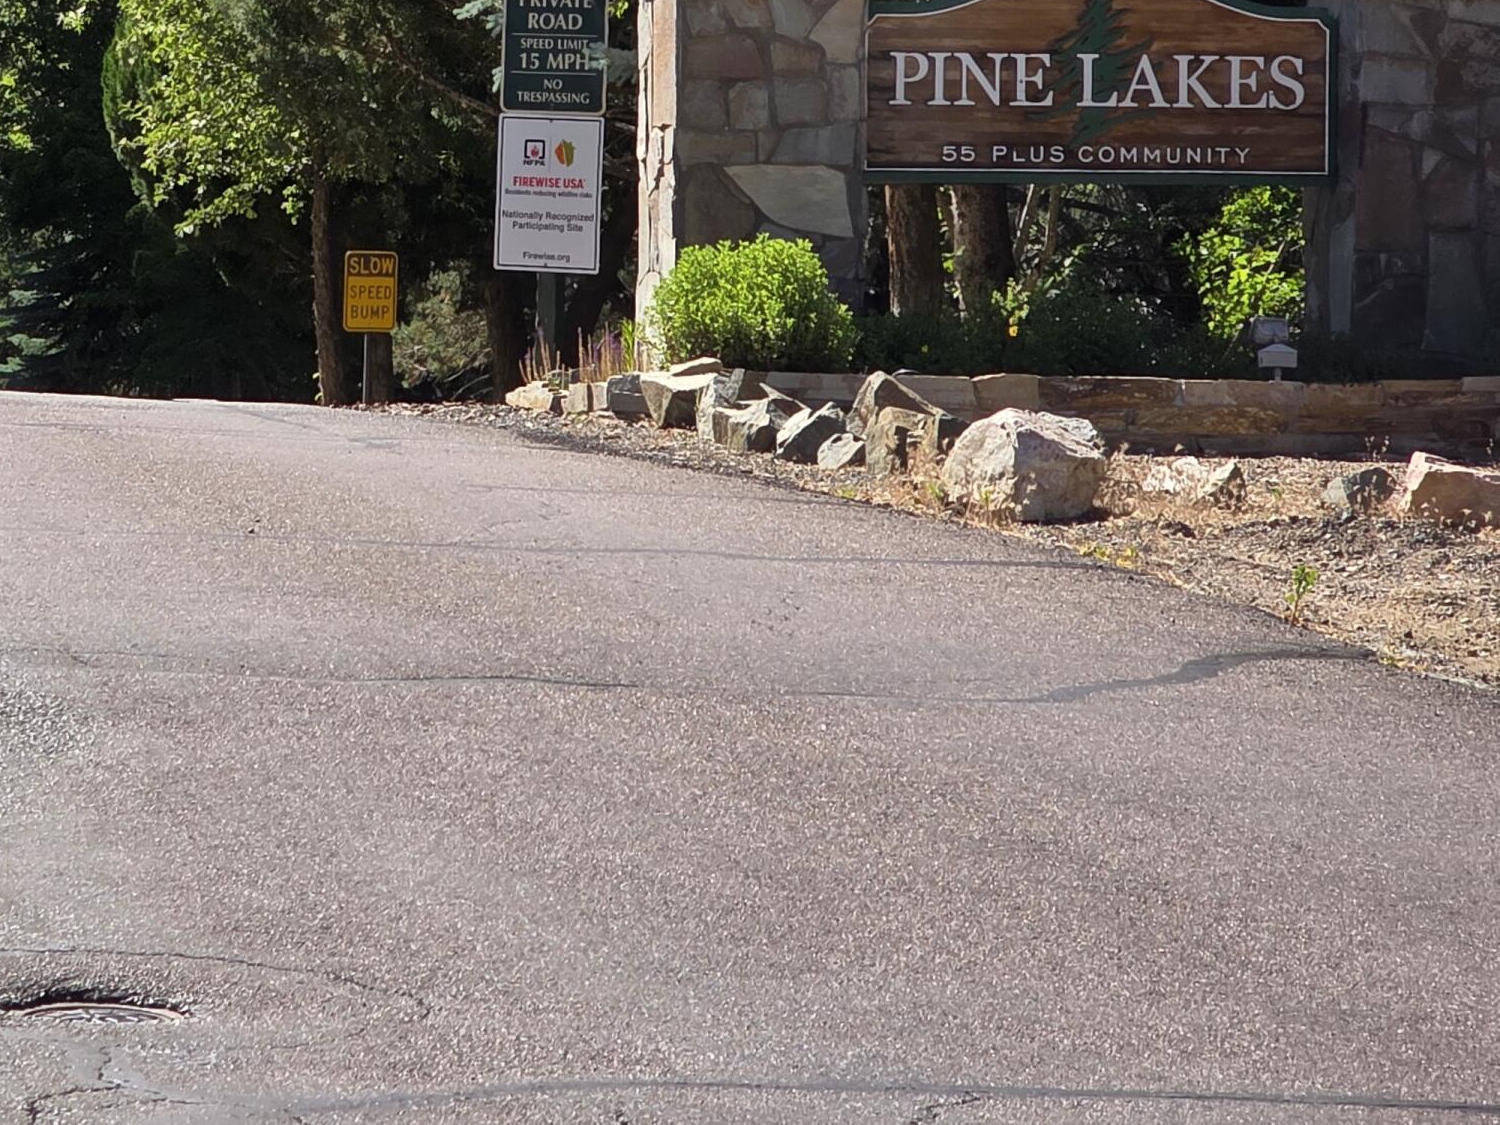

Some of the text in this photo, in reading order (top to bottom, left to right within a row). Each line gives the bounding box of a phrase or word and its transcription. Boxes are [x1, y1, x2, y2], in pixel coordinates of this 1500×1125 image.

[527, 12, 583, 30] ROAD
[520, 37, 589, 51] SPEED LIMIT
[520, 52, 590, 71] 15 MPH
[543, 78, 563, 90] NO
[888, 51, 1305, 110] PINE LAKES
[517, 90, 591, 105] TRESPASSING
[941, 145, 1251, 165] 55 PLUS COMMUNITY
[512, 176, 561, 188] FIREWISE
[502, 210, 594, 223] Nationally Recognized
[512, 220, 583, 233] Participating Site
[523, 251, 571, 263] Firewise.org
[349, 257, 394, 274] SLOW
[350, 285, 392, 300] SPEED
[351, 305, 390, 320] BUMP
